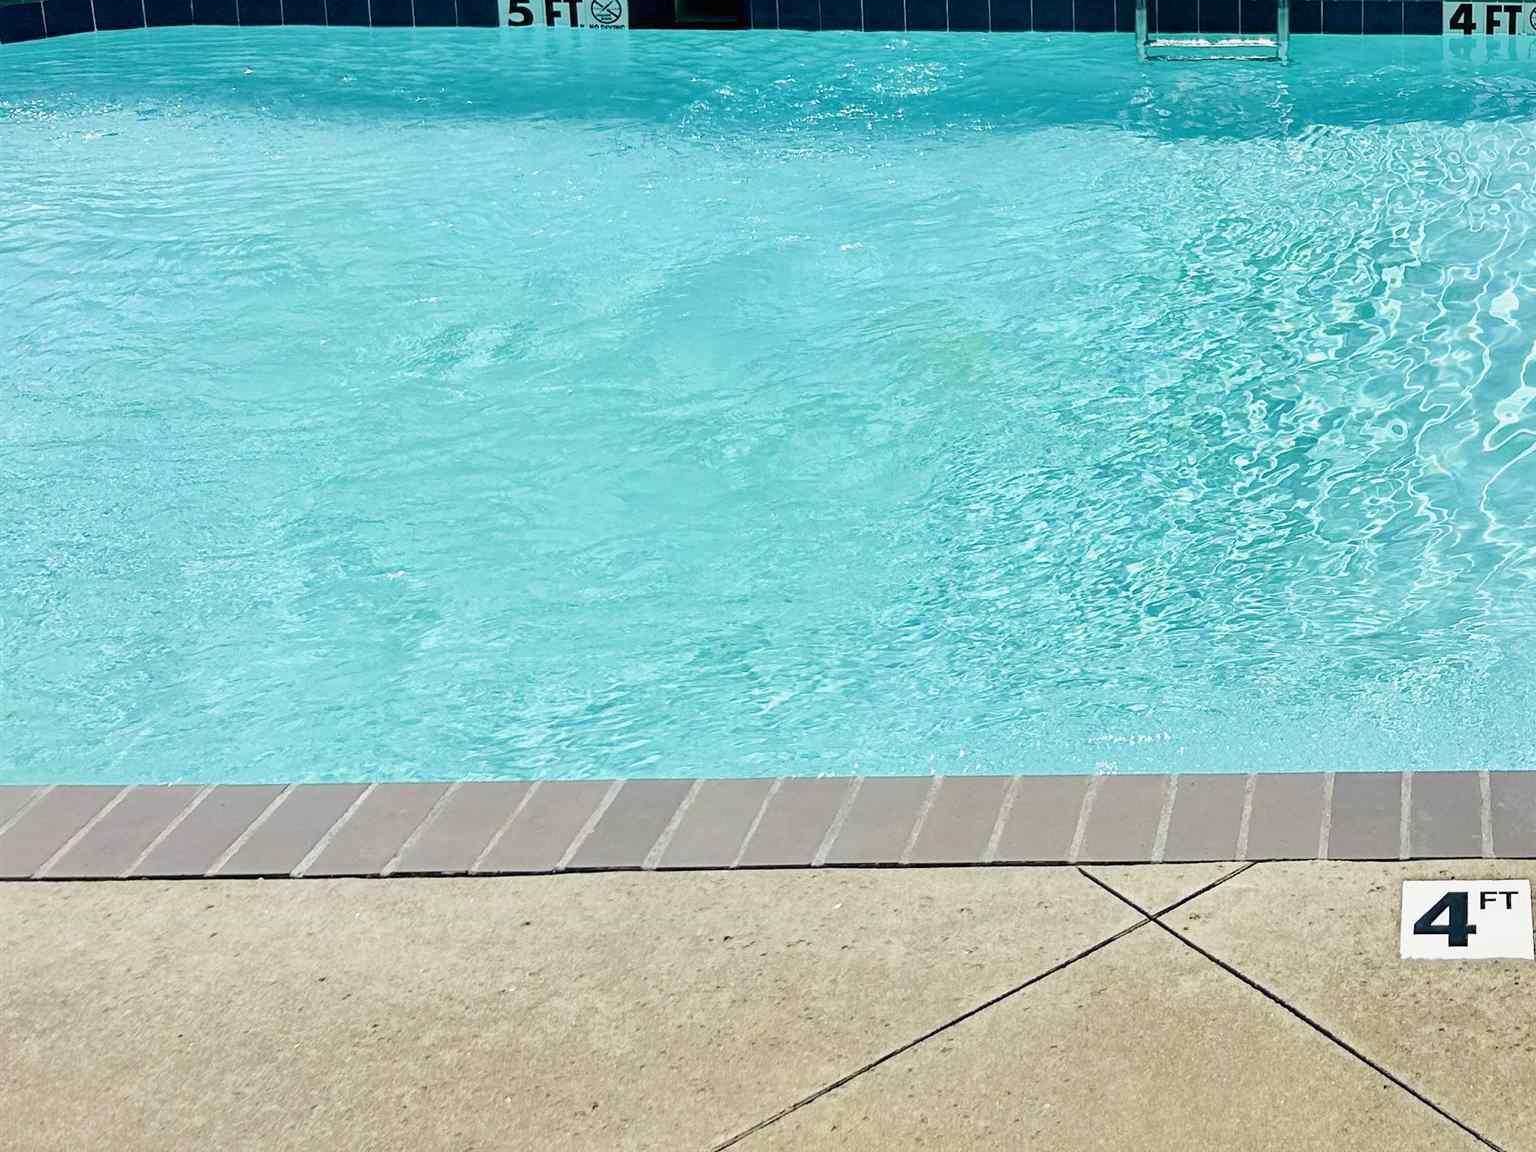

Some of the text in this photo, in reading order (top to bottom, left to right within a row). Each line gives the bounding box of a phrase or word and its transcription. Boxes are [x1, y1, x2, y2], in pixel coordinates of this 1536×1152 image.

[1449, 3, 1523, 36] 4 FT
[1413, 891, 1519, 947] 4 FT
